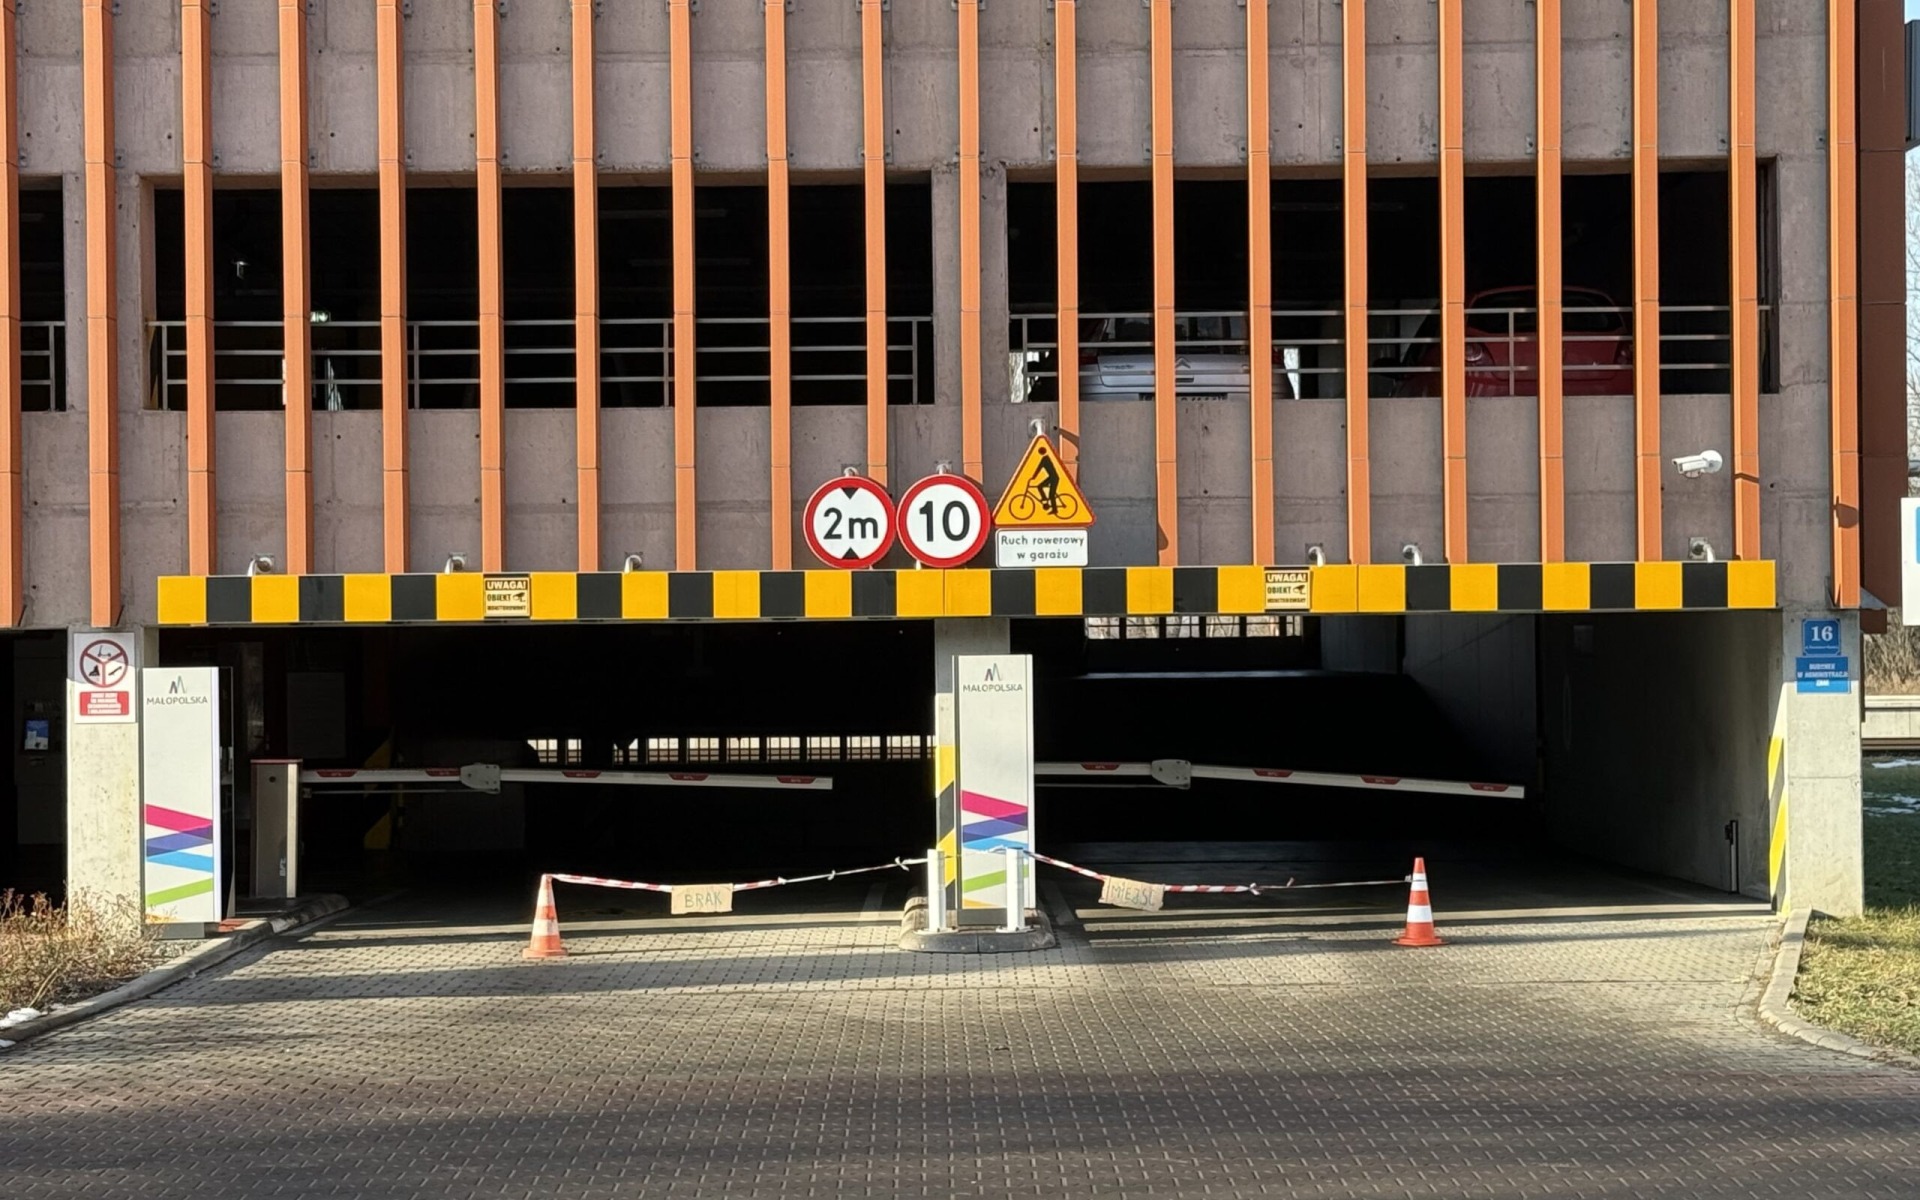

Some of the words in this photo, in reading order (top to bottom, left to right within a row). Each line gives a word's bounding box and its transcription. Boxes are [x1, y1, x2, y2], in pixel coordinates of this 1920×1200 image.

[919, 500, 970, 542] 10
[1001, 535, 1028, 545] Ruch
[1032, 537, 1084, 547] rowerowy
[1017, 551, 1026, 559] w
[1030, 549, 1068, 562] garażu
[1267, 573, 1306, 582] UWAGA!
[487, 580, 526, 590] UWAGA!
[1811, 625, 1833, 642] 16
[146, 696, 208, 705] MAŁOPOLSKA
[684, 889, 723, 908] BRAK
